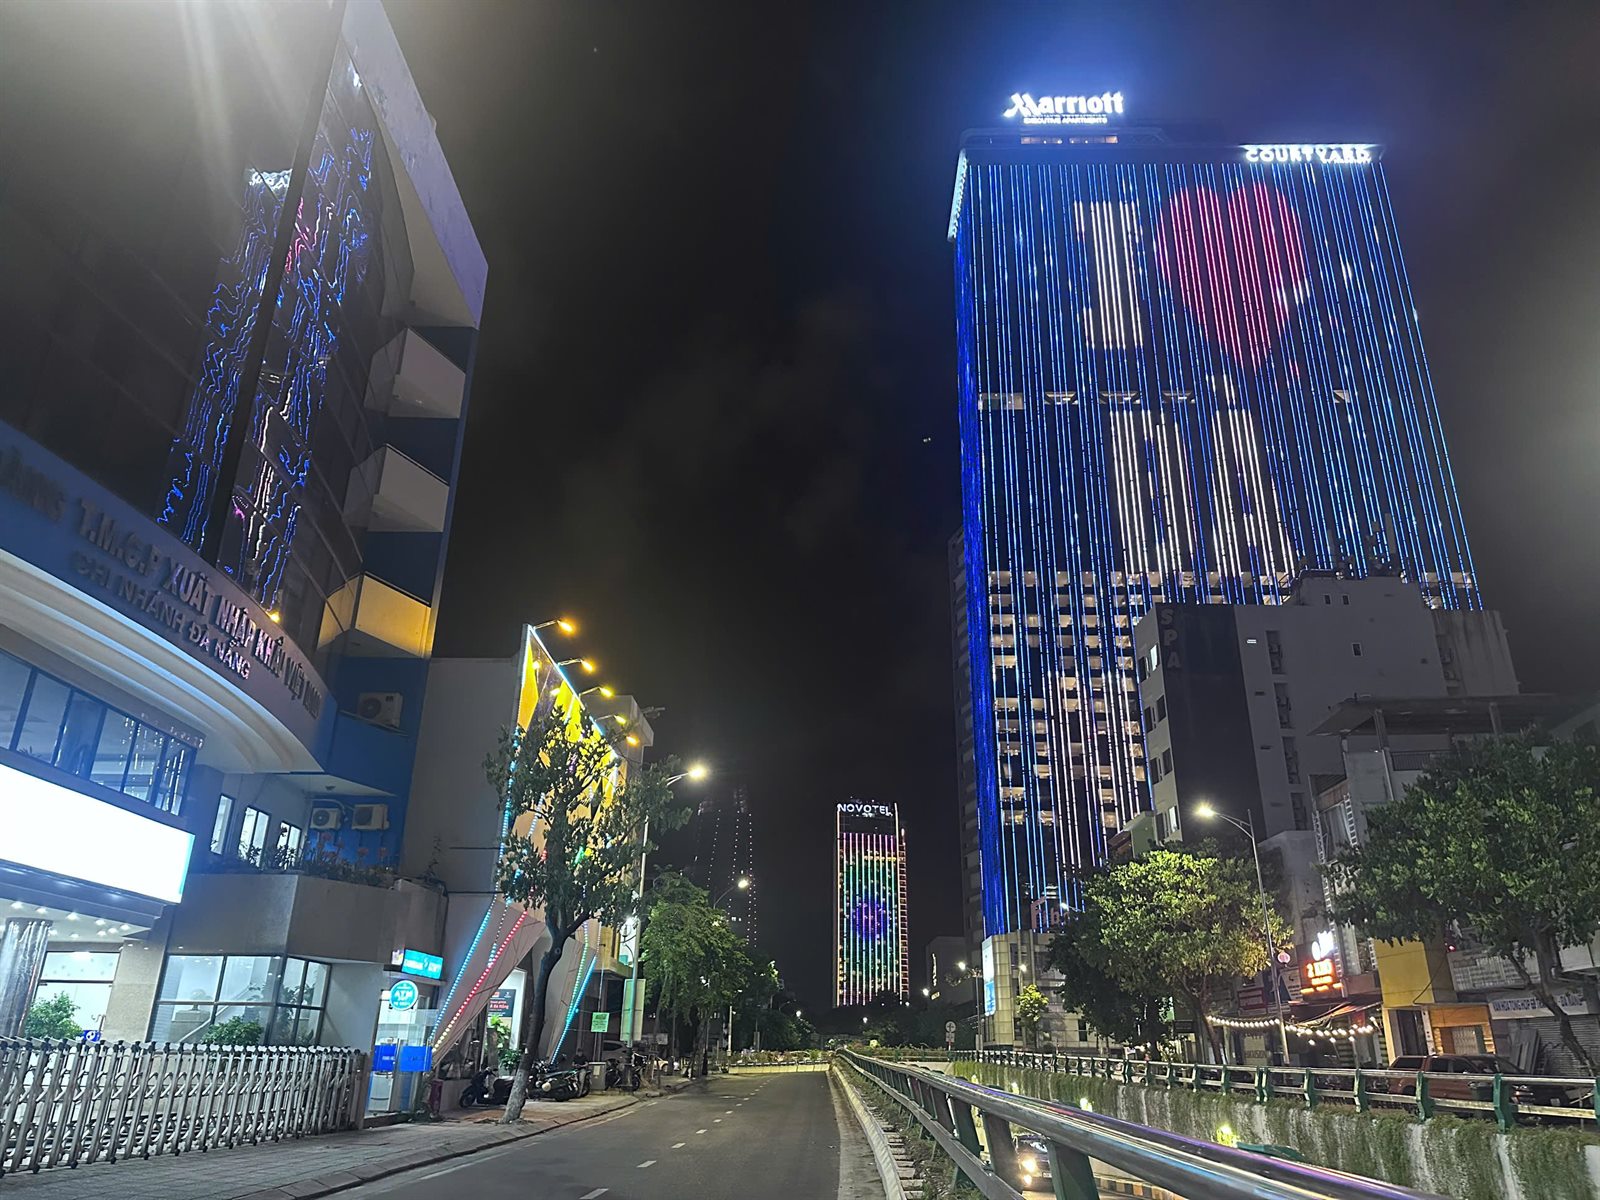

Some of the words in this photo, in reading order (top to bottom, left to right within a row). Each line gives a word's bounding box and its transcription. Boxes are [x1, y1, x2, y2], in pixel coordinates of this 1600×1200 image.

[1003, 91, 1124, 118] Marriott
[1246, 145, 1372, 164] COURTYARD
[1160, 608, 1181, 669] SPA
[837, 803, 893, 816] NOVOTEL
